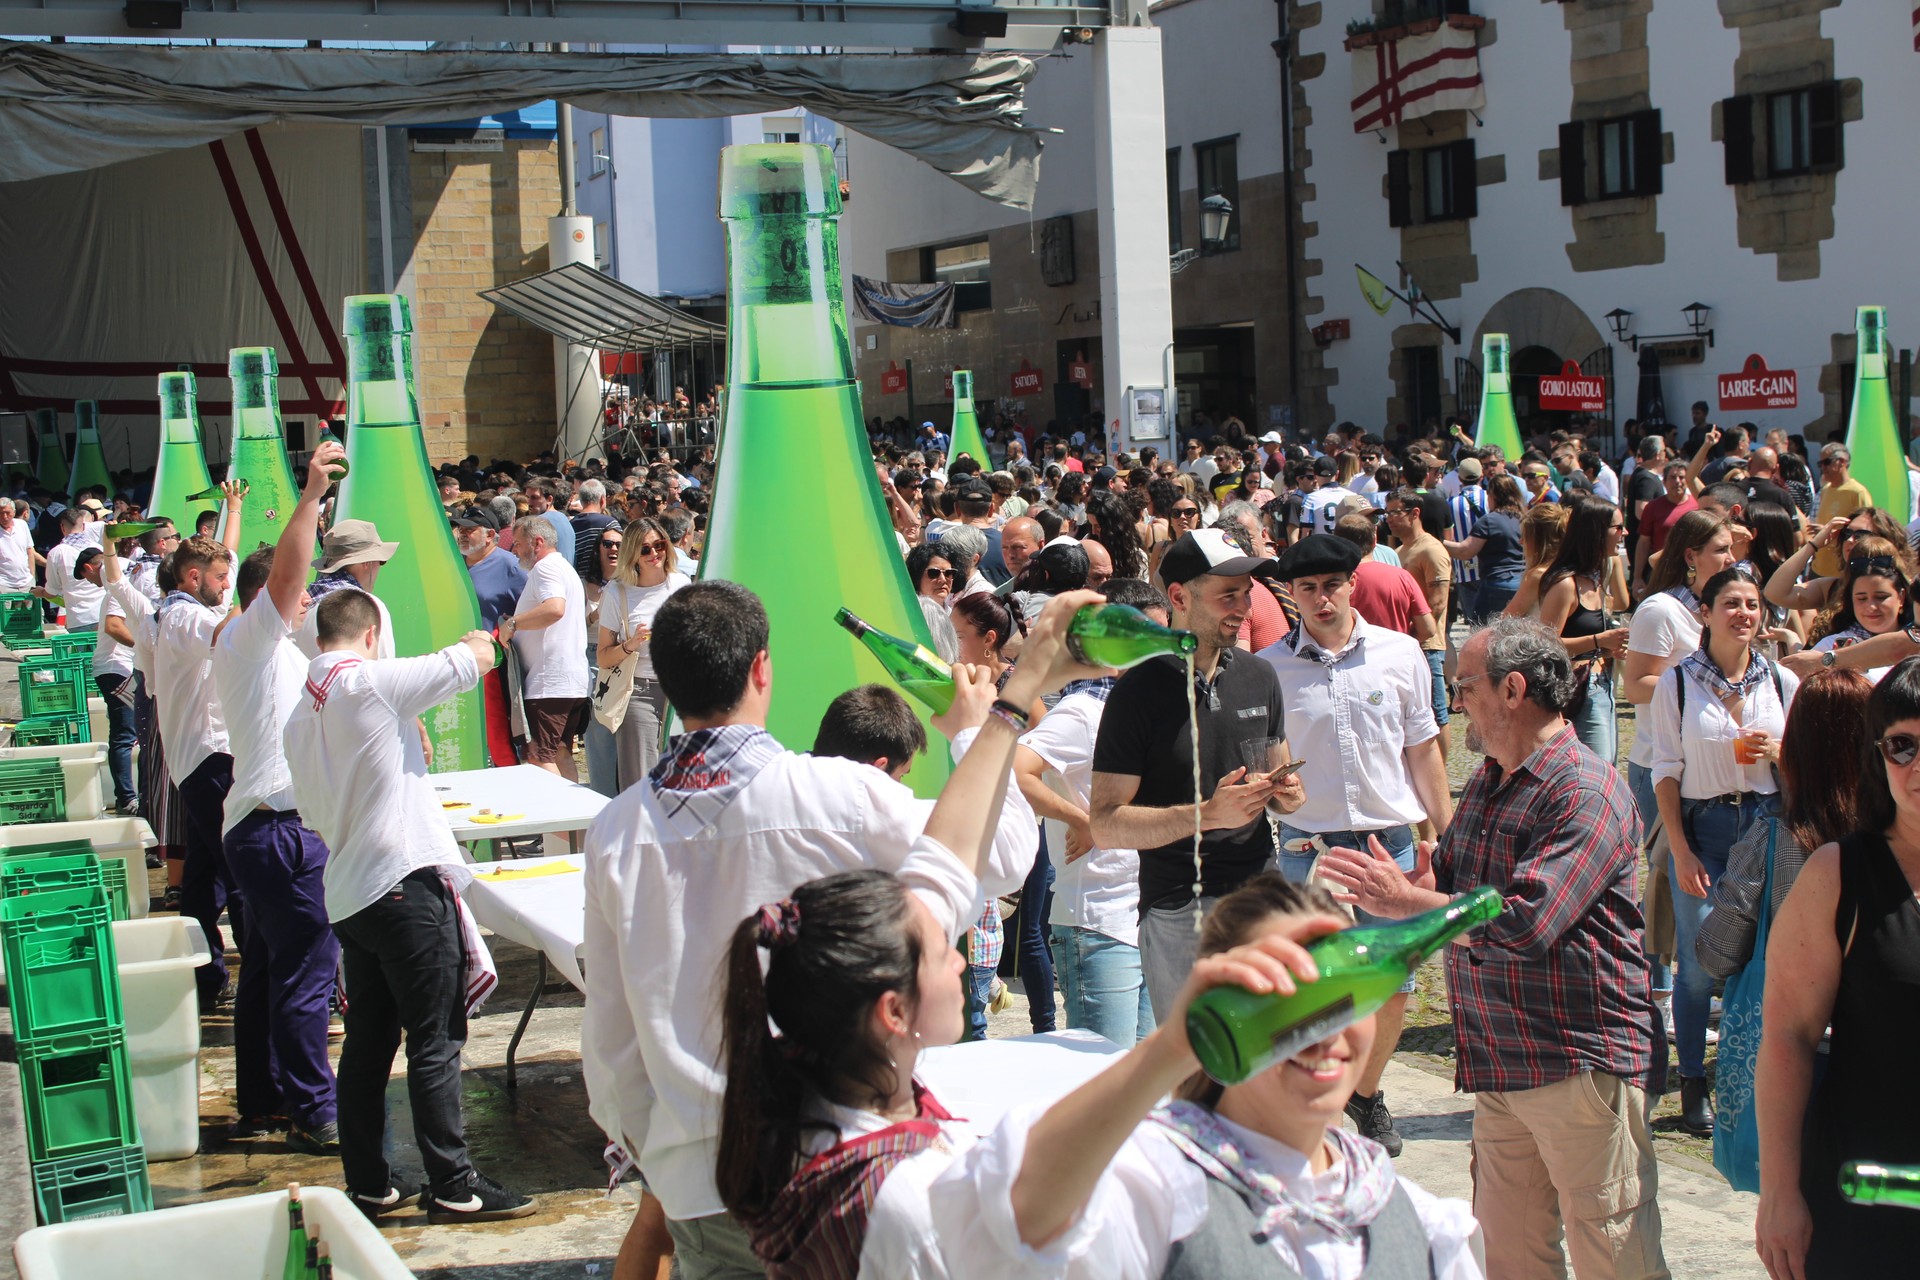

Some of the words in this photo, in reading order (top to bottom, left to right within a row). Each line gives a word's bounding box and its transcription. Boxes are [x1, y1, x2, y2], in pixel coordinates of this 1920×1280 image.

[1566, 381, 1602, 398] LASTOLA
[1720, 376, 1794, 398] LARRE-GAIN
[1767, 397, 1795, 406] HERNANI
[9, 802, 49, 811] Sagardoa
[18, 812, 41, 820] Sidra
